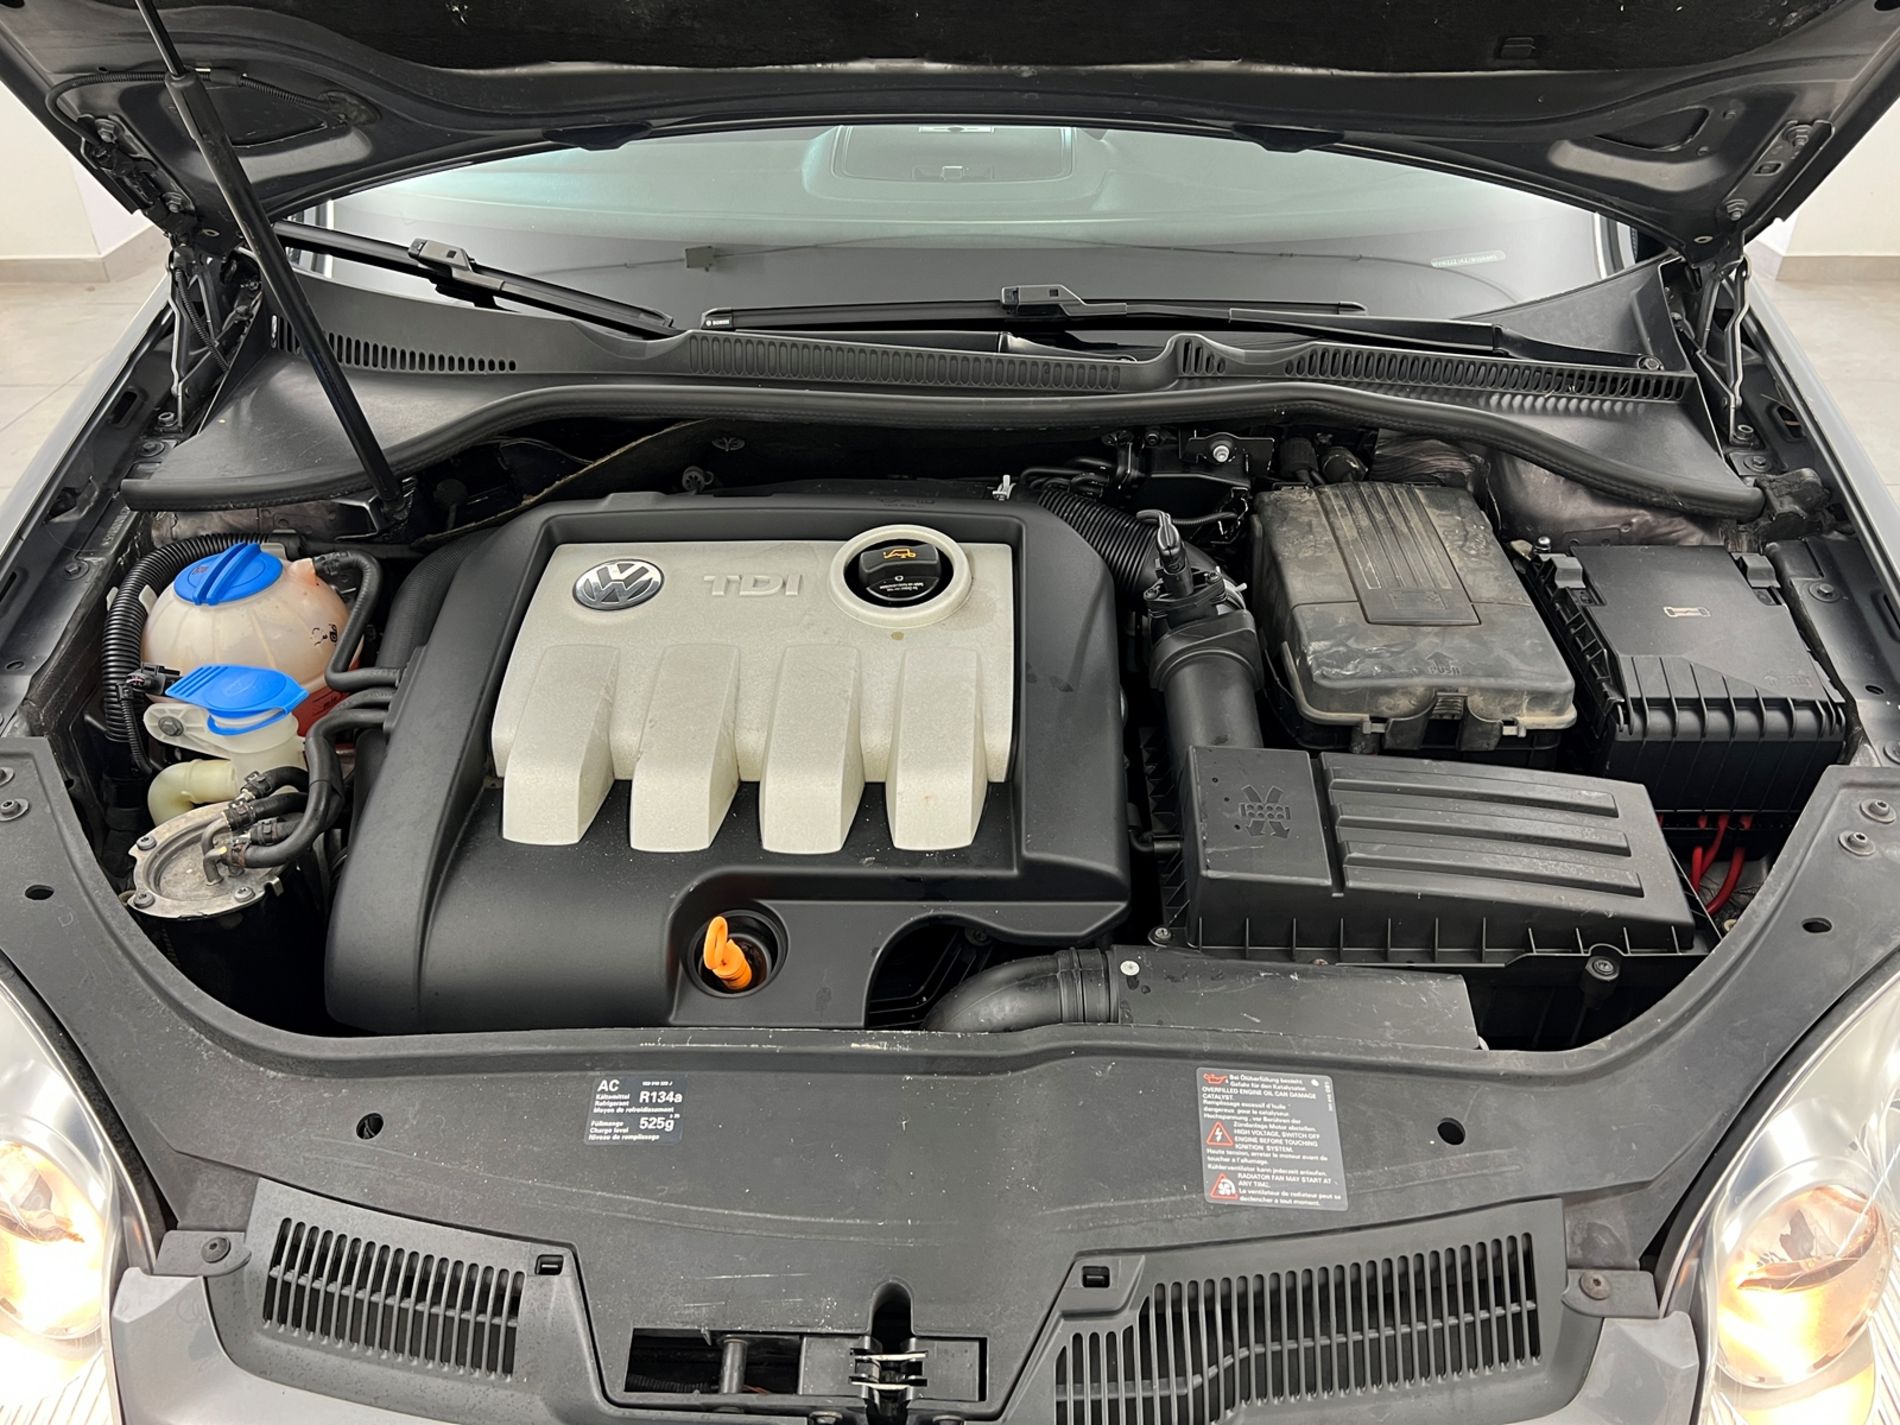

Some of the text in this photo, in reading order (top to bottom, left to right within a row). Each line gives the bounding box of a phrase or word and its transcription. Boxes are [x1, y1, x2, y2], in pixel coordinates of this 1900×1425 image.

[573, 558, 664, 611] VW
[704, 573, 804, 597] TDI
[597, 1079, 620, 1092] AC
[640, 1091, 682, 1102] R134a
[640, 1117, 674, 1131] 525g
[1238, 1173, 1270, 1181] RADIATOR
